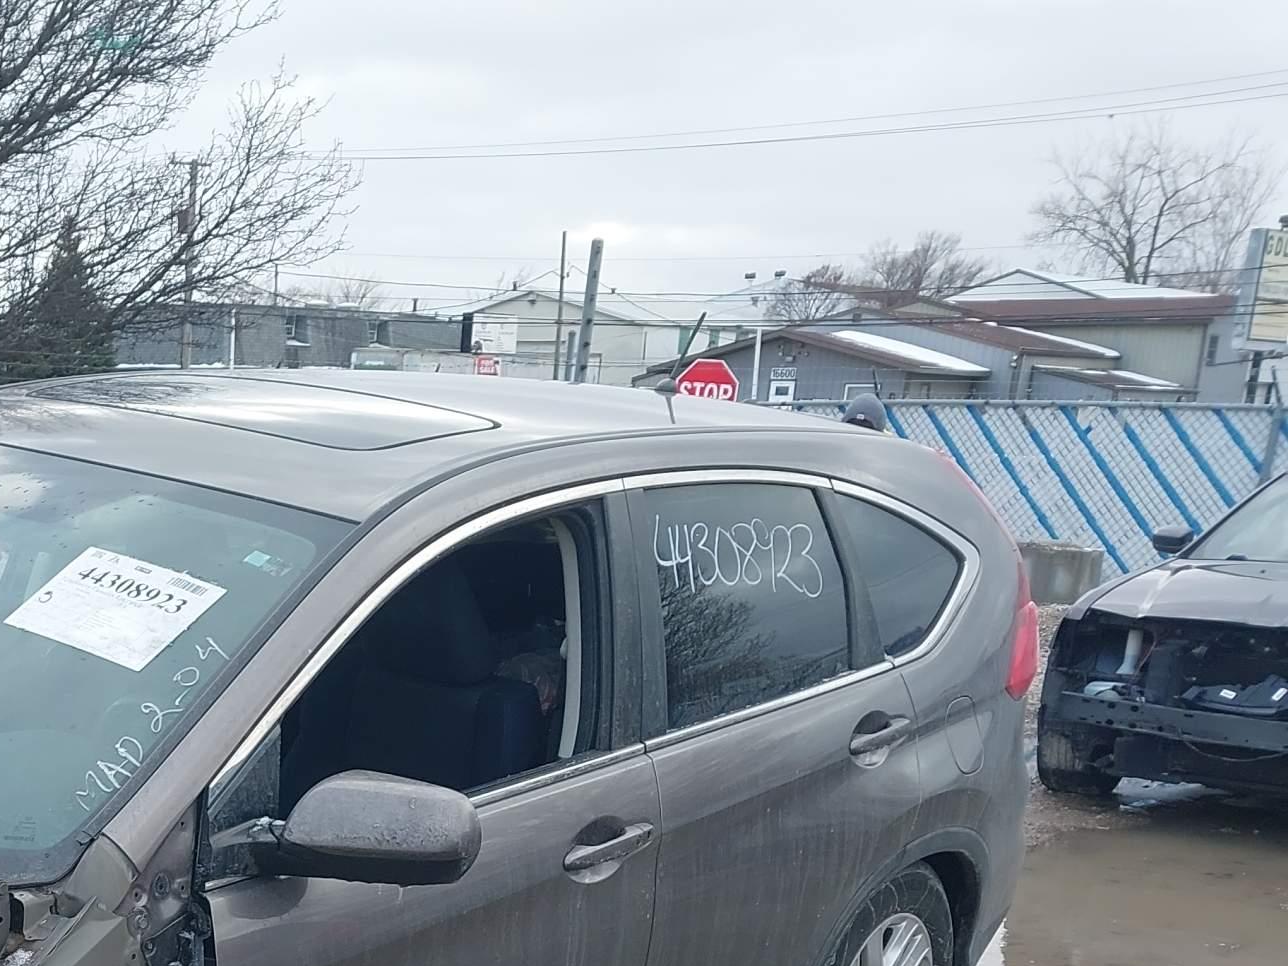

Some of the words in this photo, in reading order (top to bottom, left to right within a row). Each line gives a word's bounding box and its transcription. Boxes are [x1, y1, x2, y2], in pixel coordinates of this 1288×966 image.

[679, 380, 733, 401] STOP
[654, 514, 823, 597] 44308923
[78, 566, 188, 614] 44308923
